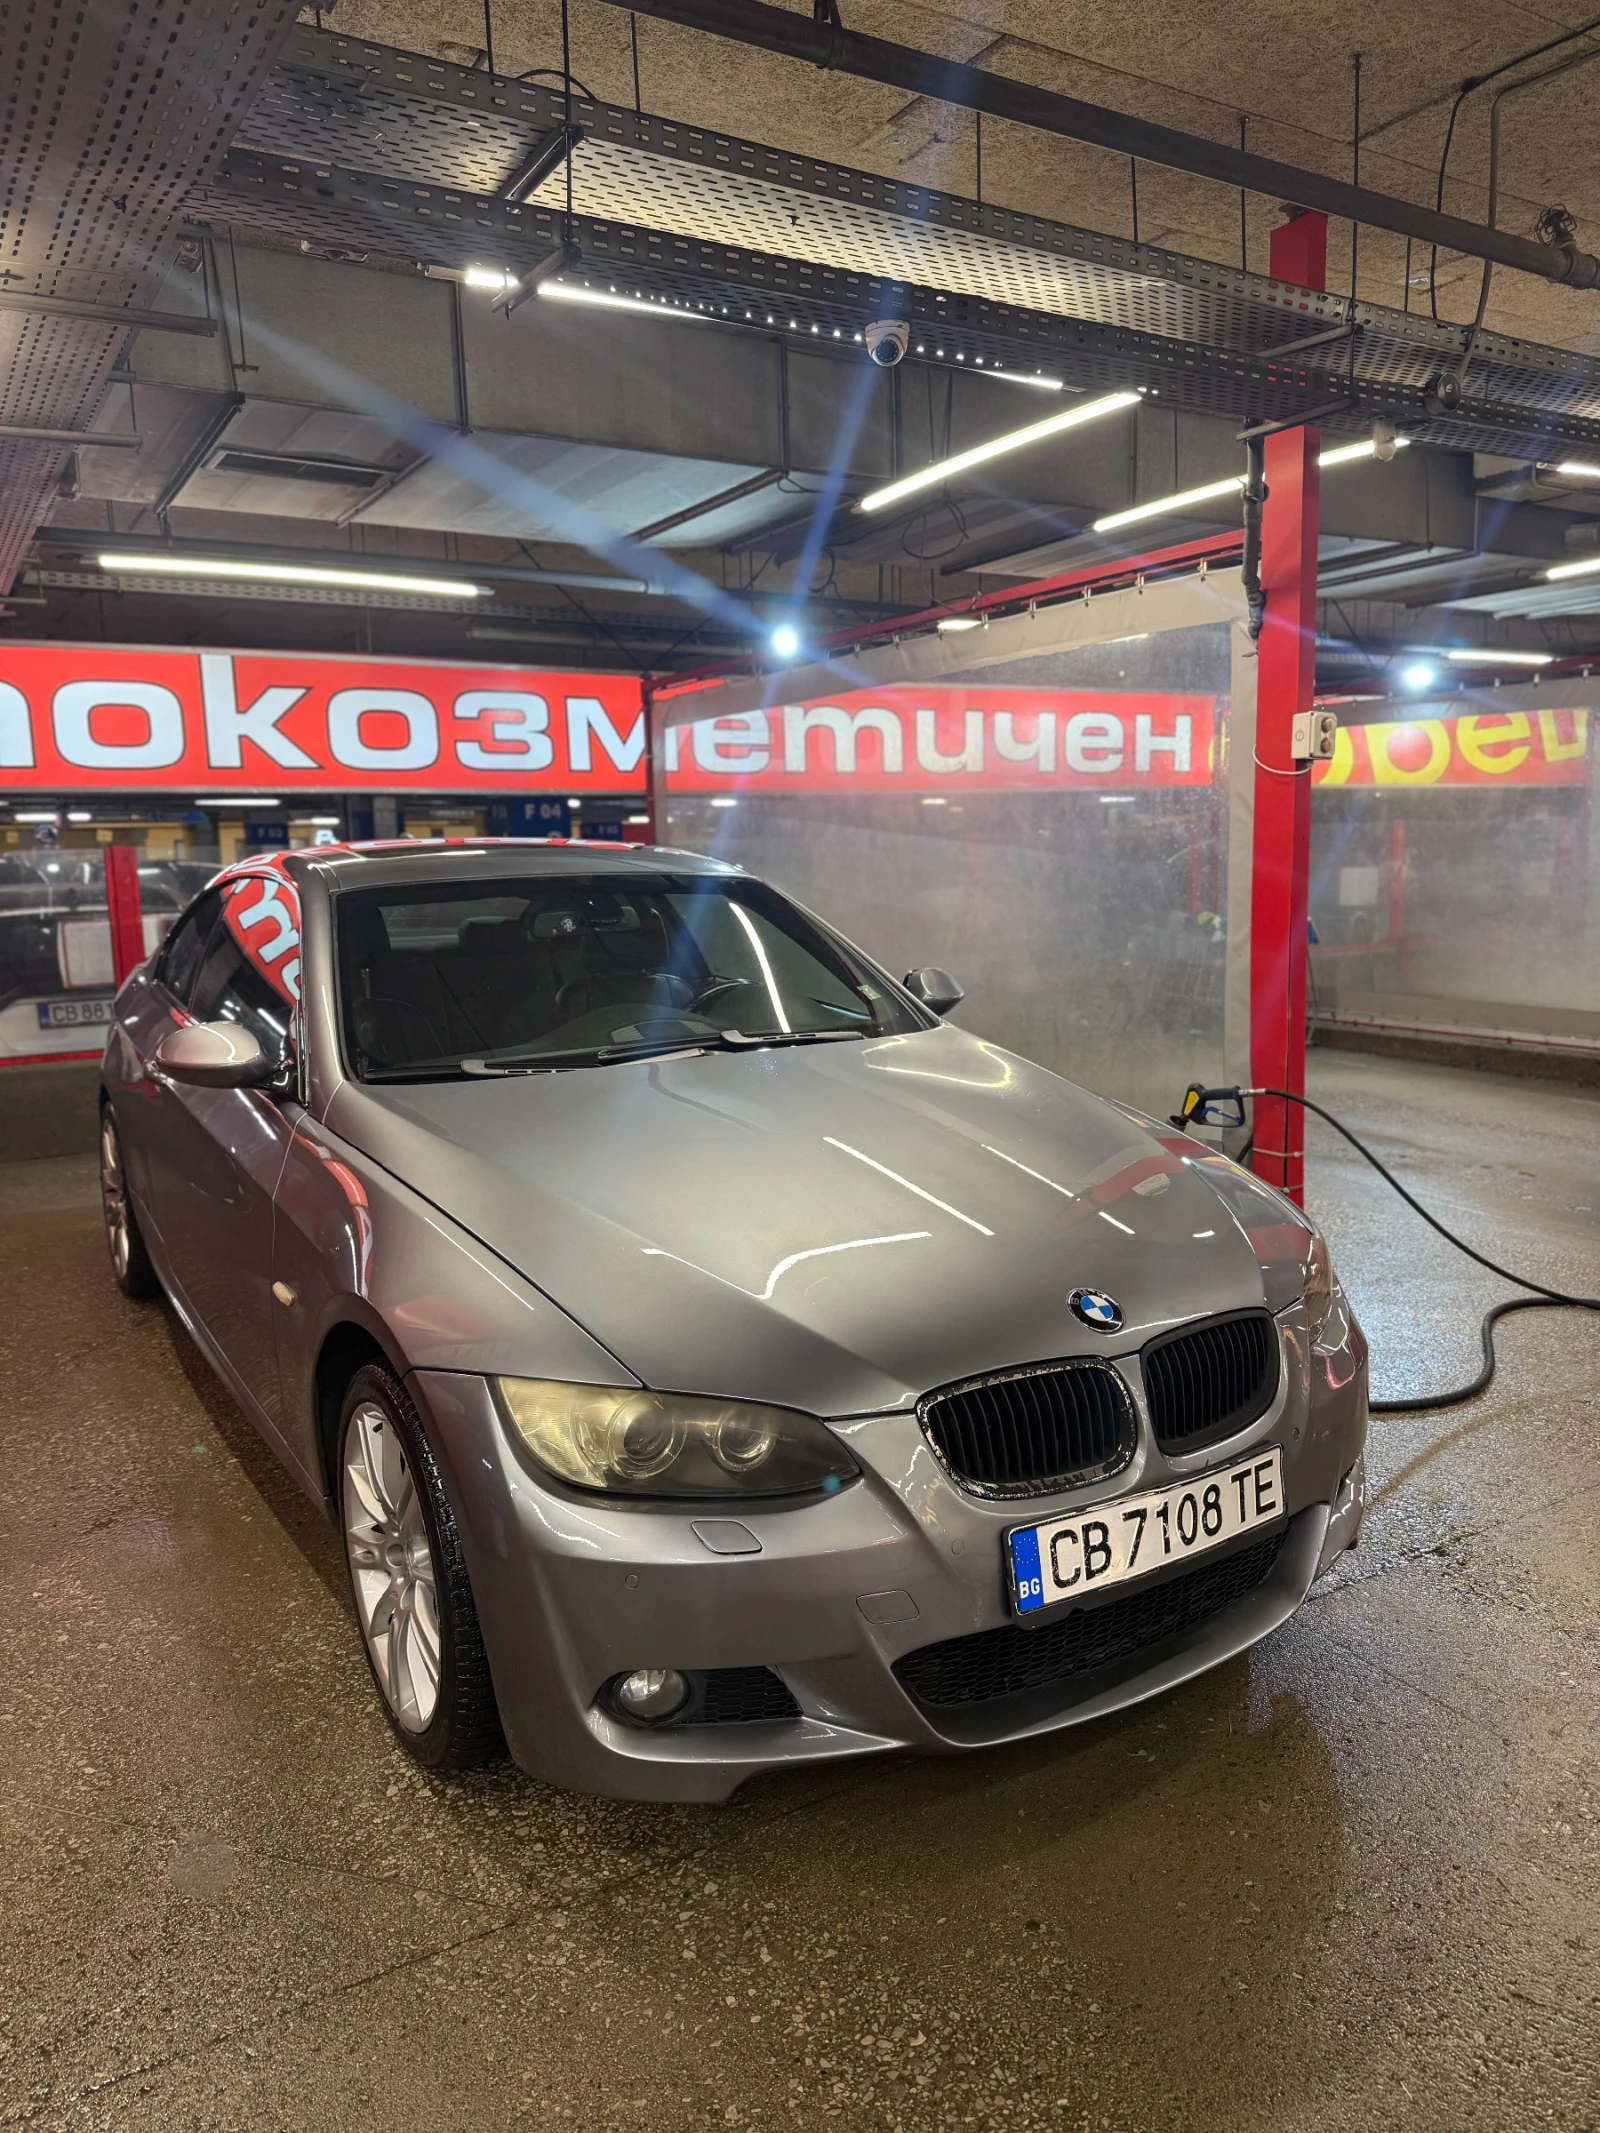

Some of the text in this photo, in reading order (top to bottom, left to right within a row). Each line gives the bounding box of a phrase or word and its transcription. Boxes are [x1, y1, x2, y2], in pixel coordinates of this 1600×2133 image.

[52, 1005, 78, 1022] CB
[1049, 1458, 1276, 1590] CB 7108 TE
[1018, 1580, 1041, 1599] BG
